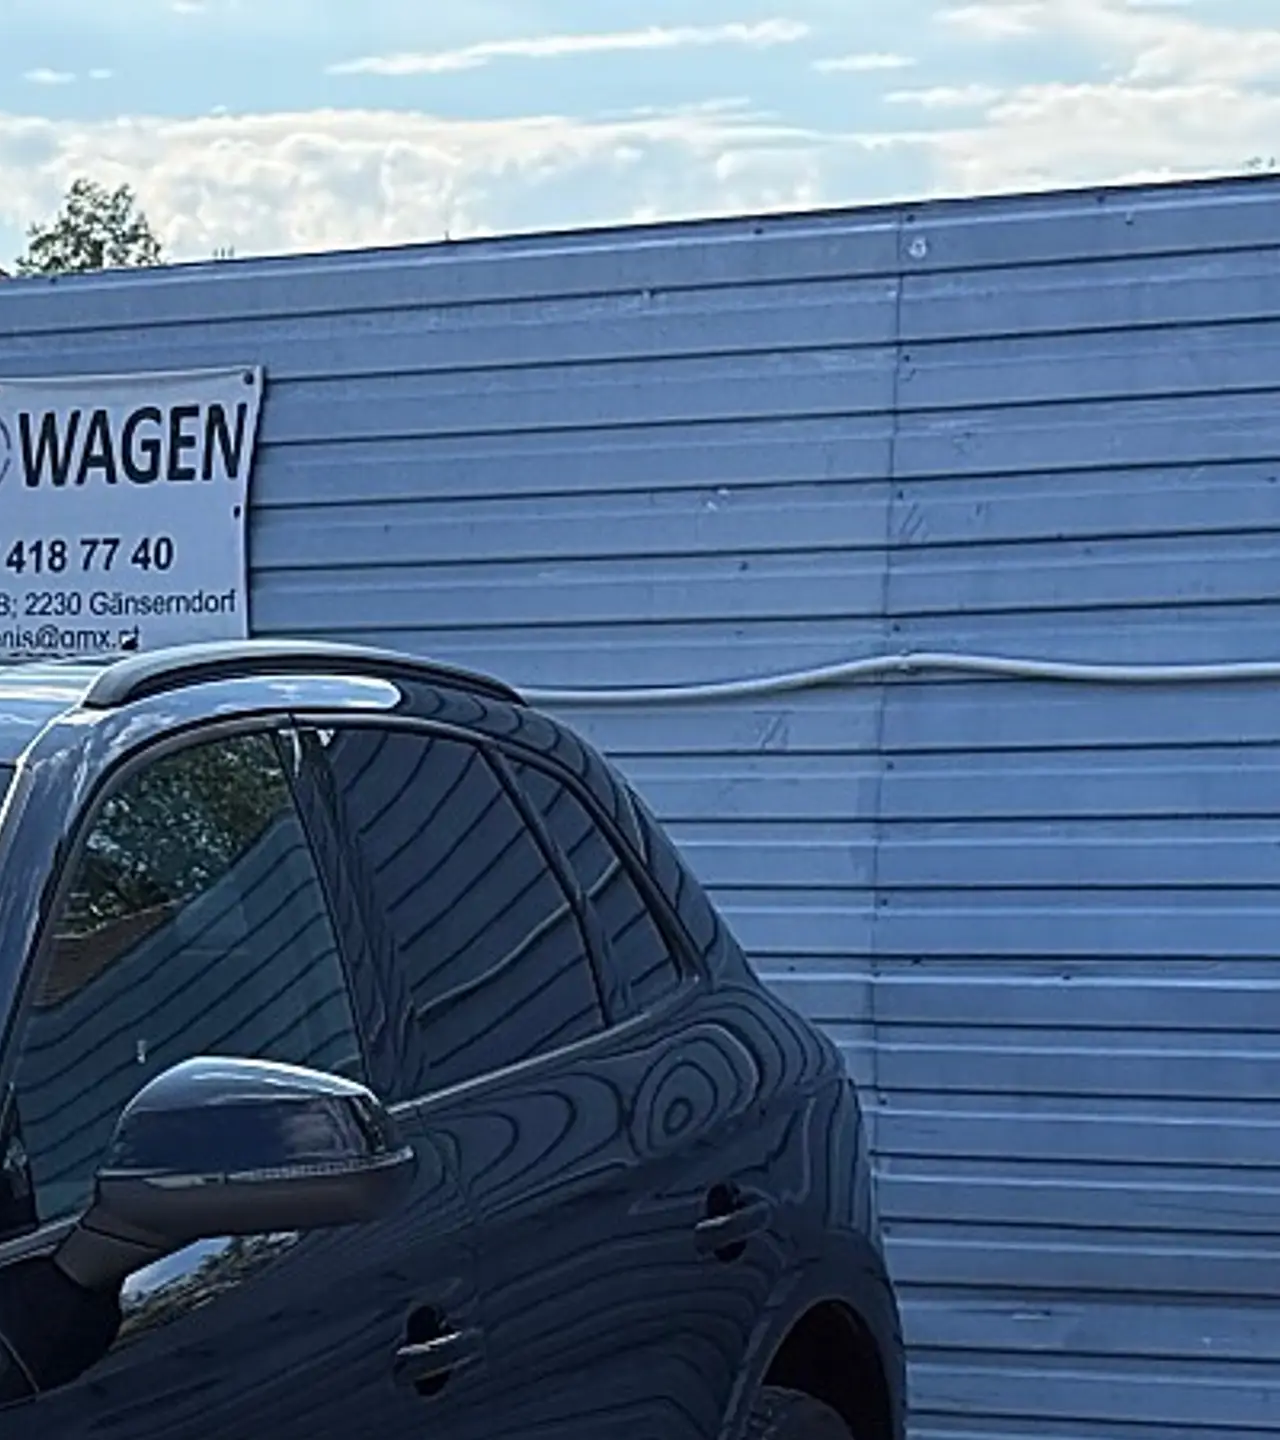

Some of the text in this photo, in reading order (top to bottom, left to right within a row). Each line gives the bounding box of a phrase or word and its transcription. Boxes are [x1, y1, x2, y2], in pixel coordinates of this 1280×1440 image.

[18, 403, 248, 490] WAGEN
[6, 539, 67, 574] 418
[80, 538, 120, 572] 77
[130, 537, 173, 572] 40
[25, 593, 83, 617] 2230
[90, 589, 236, 615] Gänserndorf
